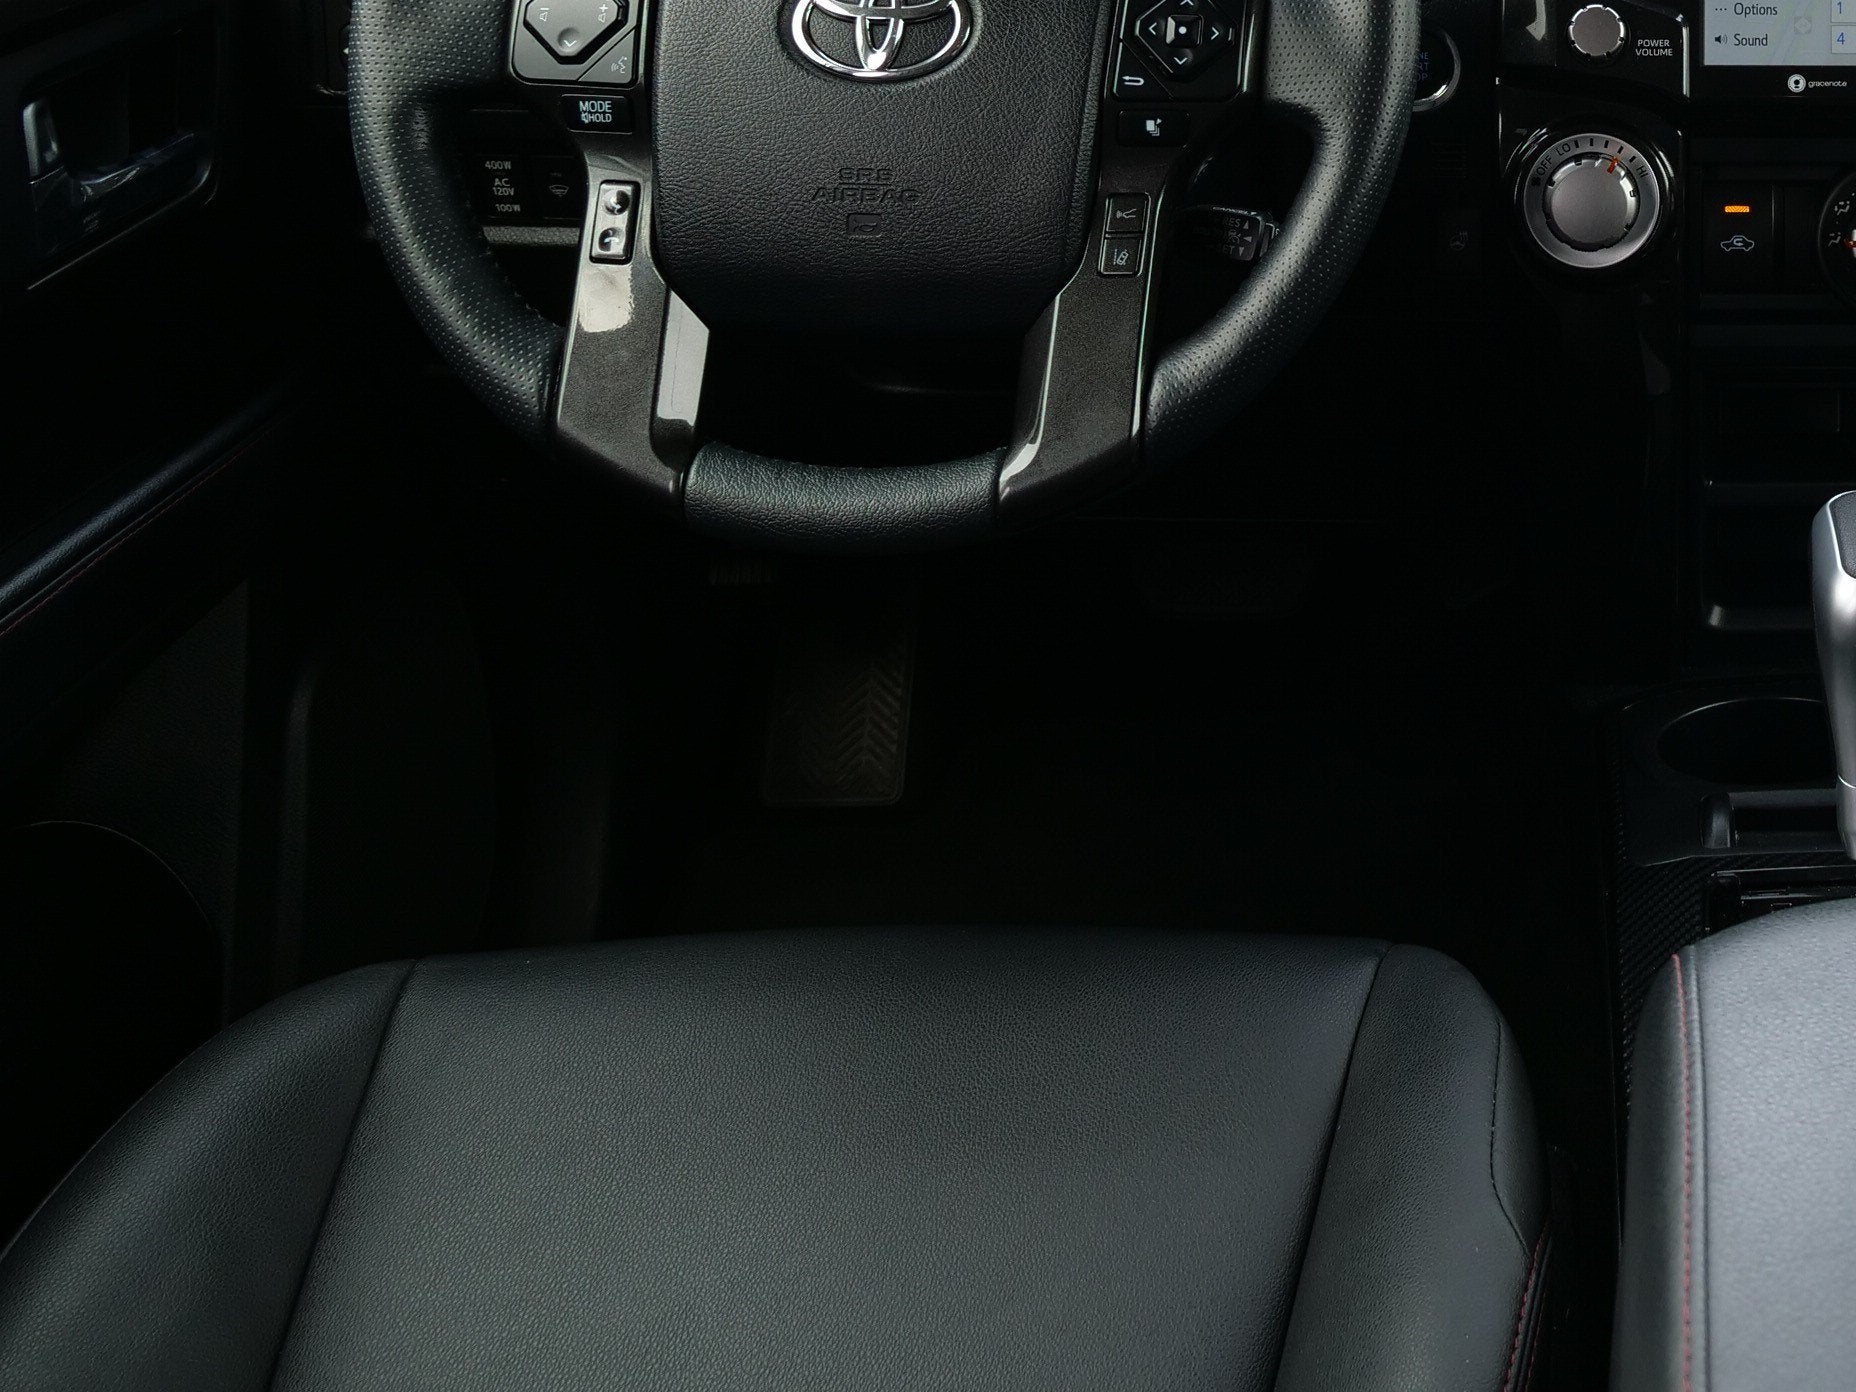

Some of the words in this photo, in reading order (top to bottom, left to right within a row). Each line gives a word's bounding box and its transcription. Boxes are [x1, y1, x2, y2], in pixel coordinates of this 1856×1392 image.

[1733, 2, 1778, 18] Options
[1836, 1, 1843, 14] 1
[1637, 39, 1670, 47] POWER
[1733, 33, 1768, 47] Sound
[1836, 32, 1846, 45] 4
[1635, 48, 1673, 57] VOLUME
[1808, 79, 1848, 88] gracenote
[579, 101, 612, 113] MODE
[589, 113, 613, 123] HOLD
[1555, 143, 1572, 156] LO
[485, 161, 512, 170] 400W
[1538, 155, 1553, 177] OFF
[839, 167, 893, 181] SRS
[1637, 166, 1649, 178] HI
[494, 178, 511, 187] AC
[492, 187, 515, 196] 120V
[811, 187, 922, 204] AIRBAG
[495, 203, 521, 213] 100W
